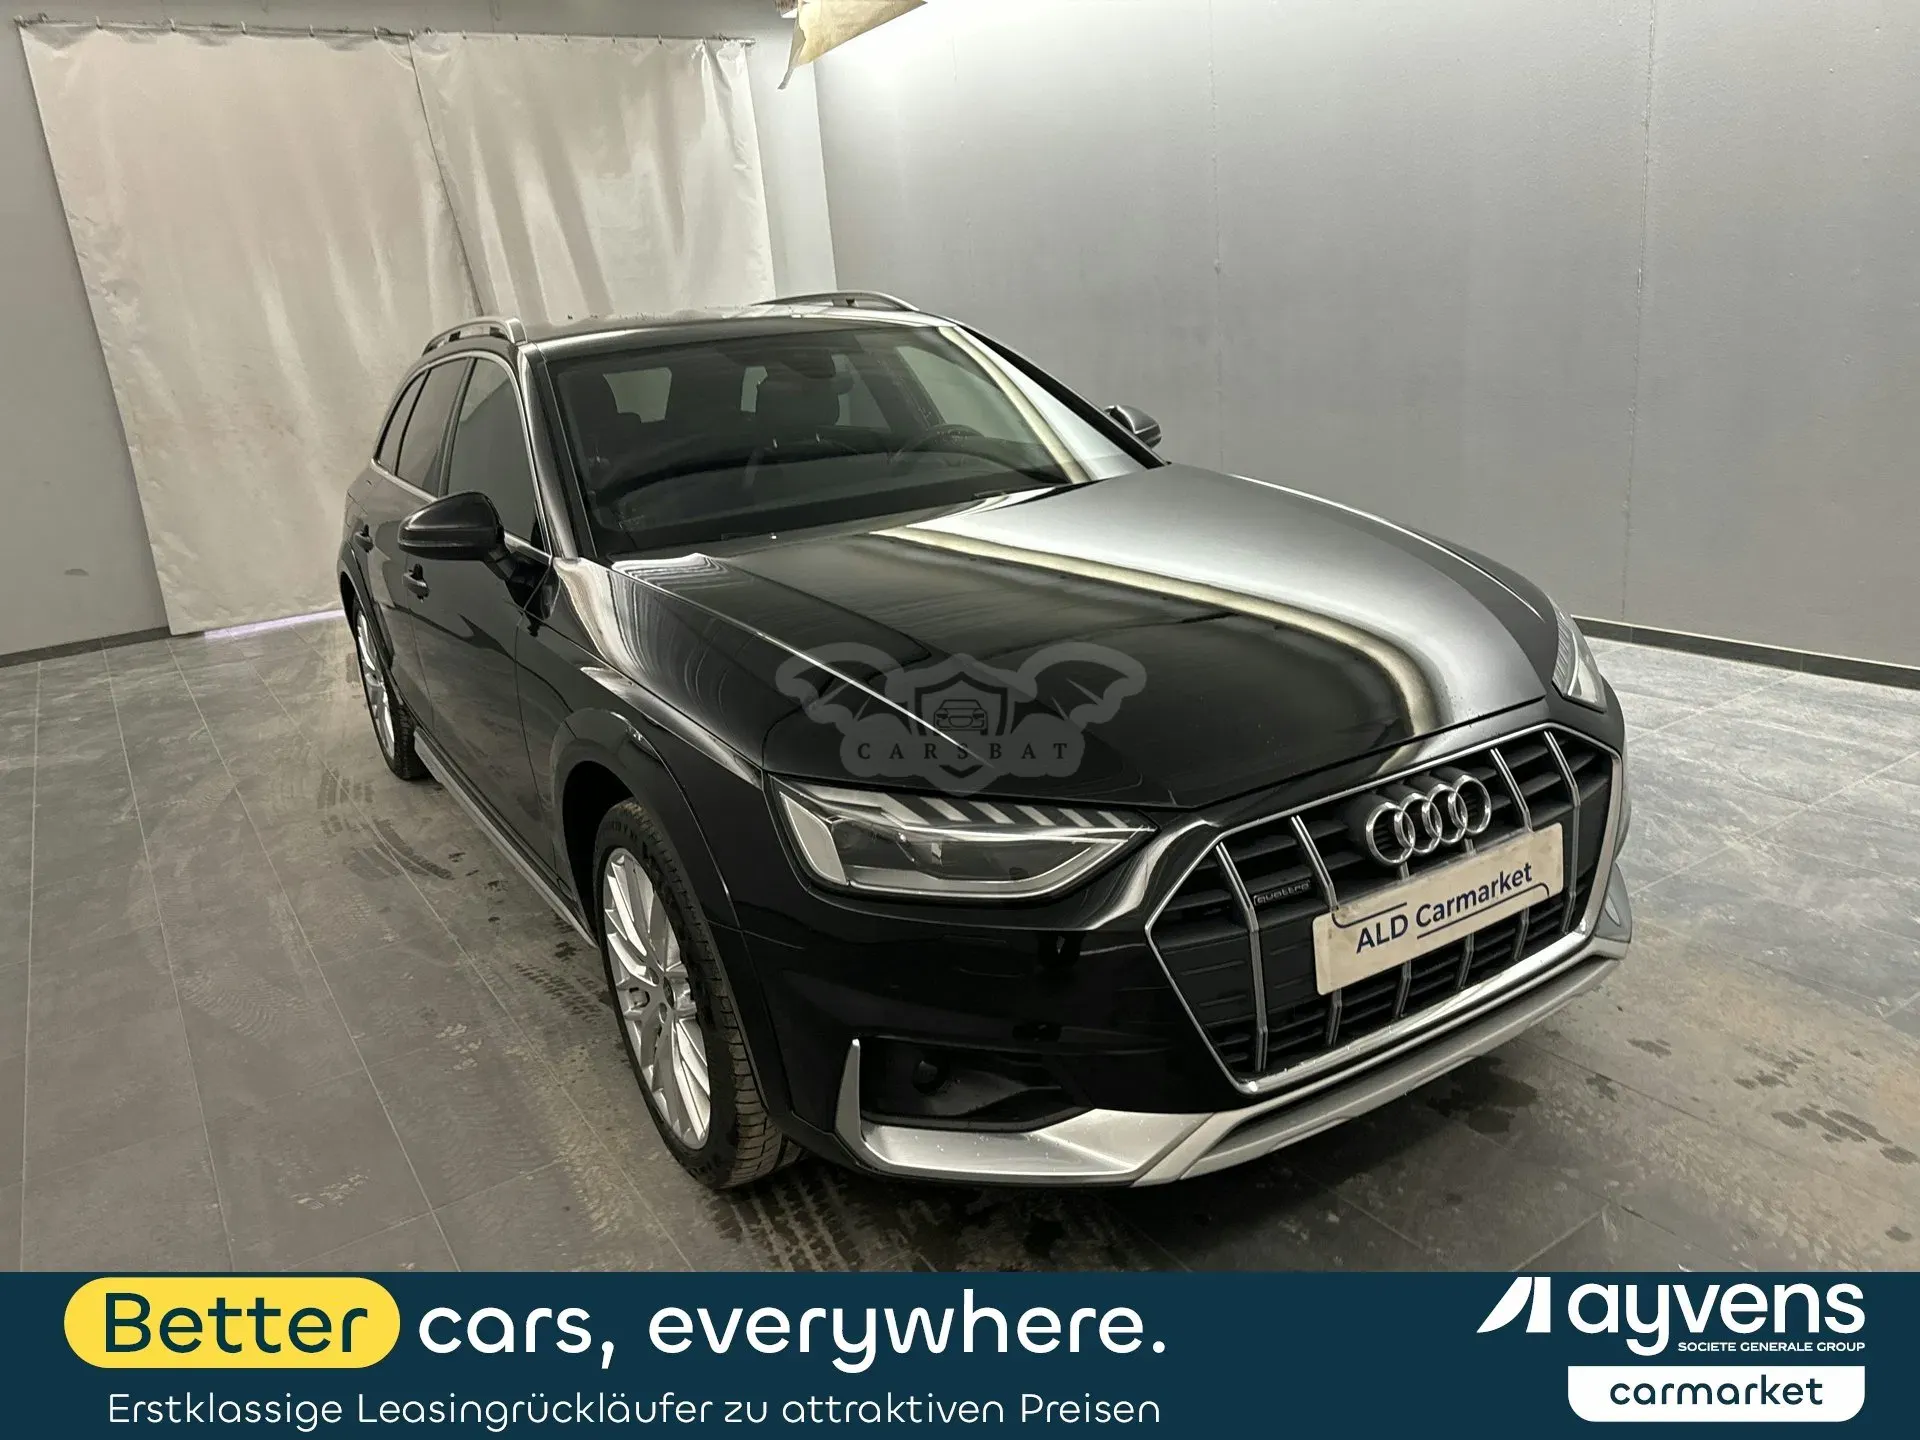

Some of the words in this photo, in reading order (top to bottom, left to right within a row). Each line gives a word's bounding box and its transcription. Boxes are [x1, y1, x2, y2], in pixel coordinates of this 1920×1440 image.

[1253, 880, 1311, 906] quattro
[1356, 914, 1409, 953] ALD
[1415, 862, 1533, 928] Carmarket
